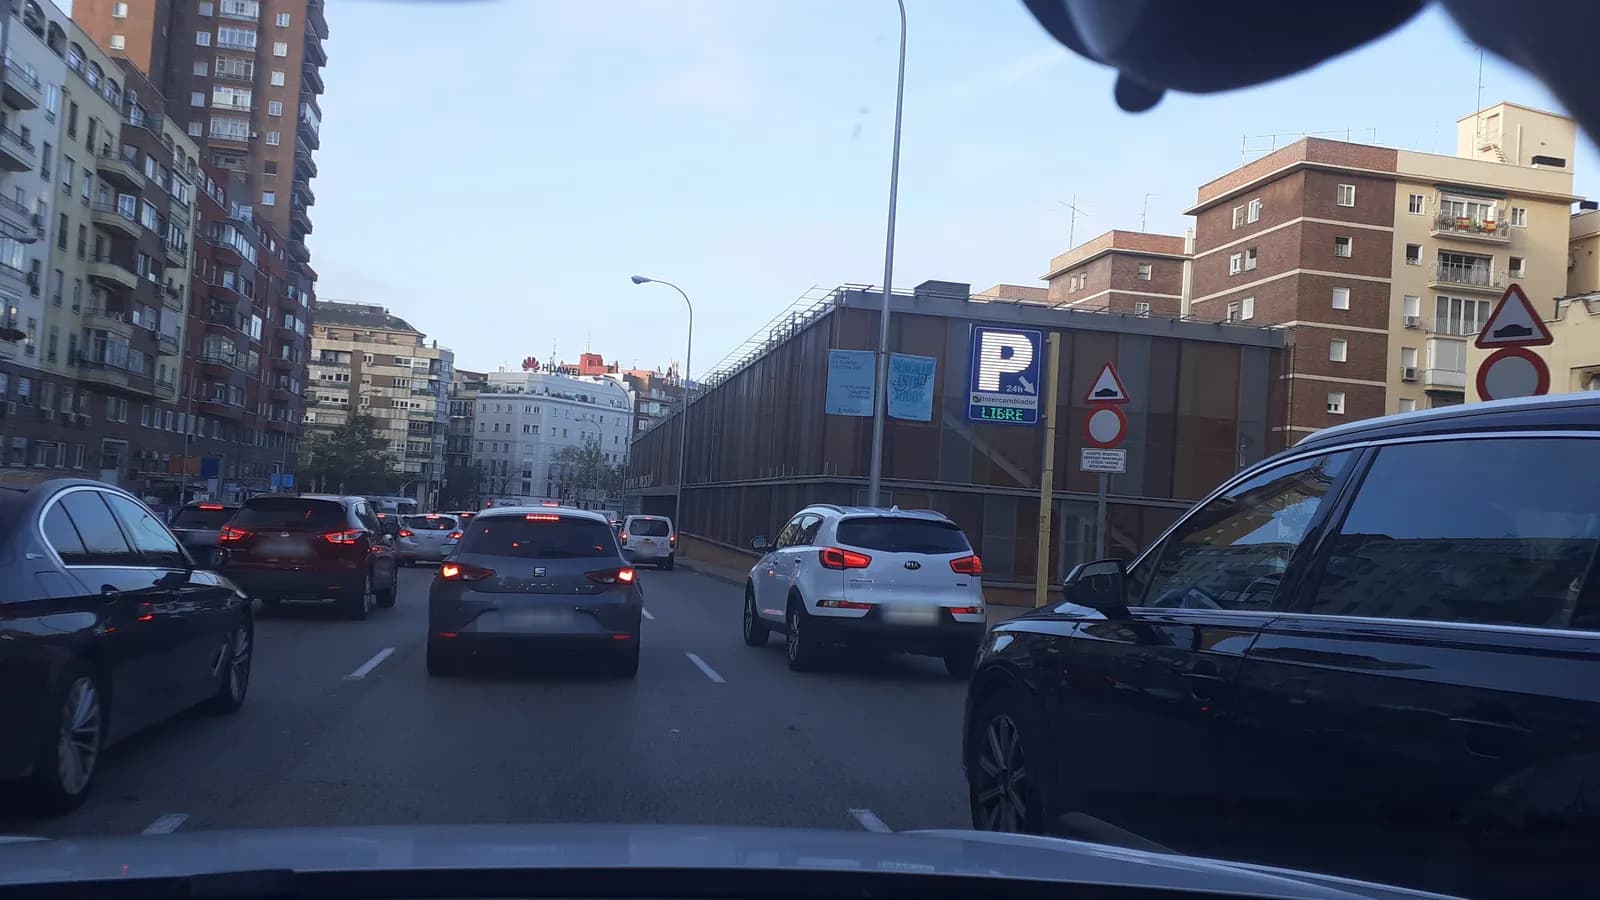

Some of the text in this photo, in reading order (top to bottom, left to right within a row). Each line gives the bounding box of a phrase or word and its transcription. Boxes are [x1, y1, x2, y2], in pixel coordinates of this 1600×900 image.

[978, 332, 1033, 391] P
[542, 363, 581, 376] HUAWEI
[1006, 384, 1023, 393] 24h
[981, 406, 1024, 421] LIBRE
